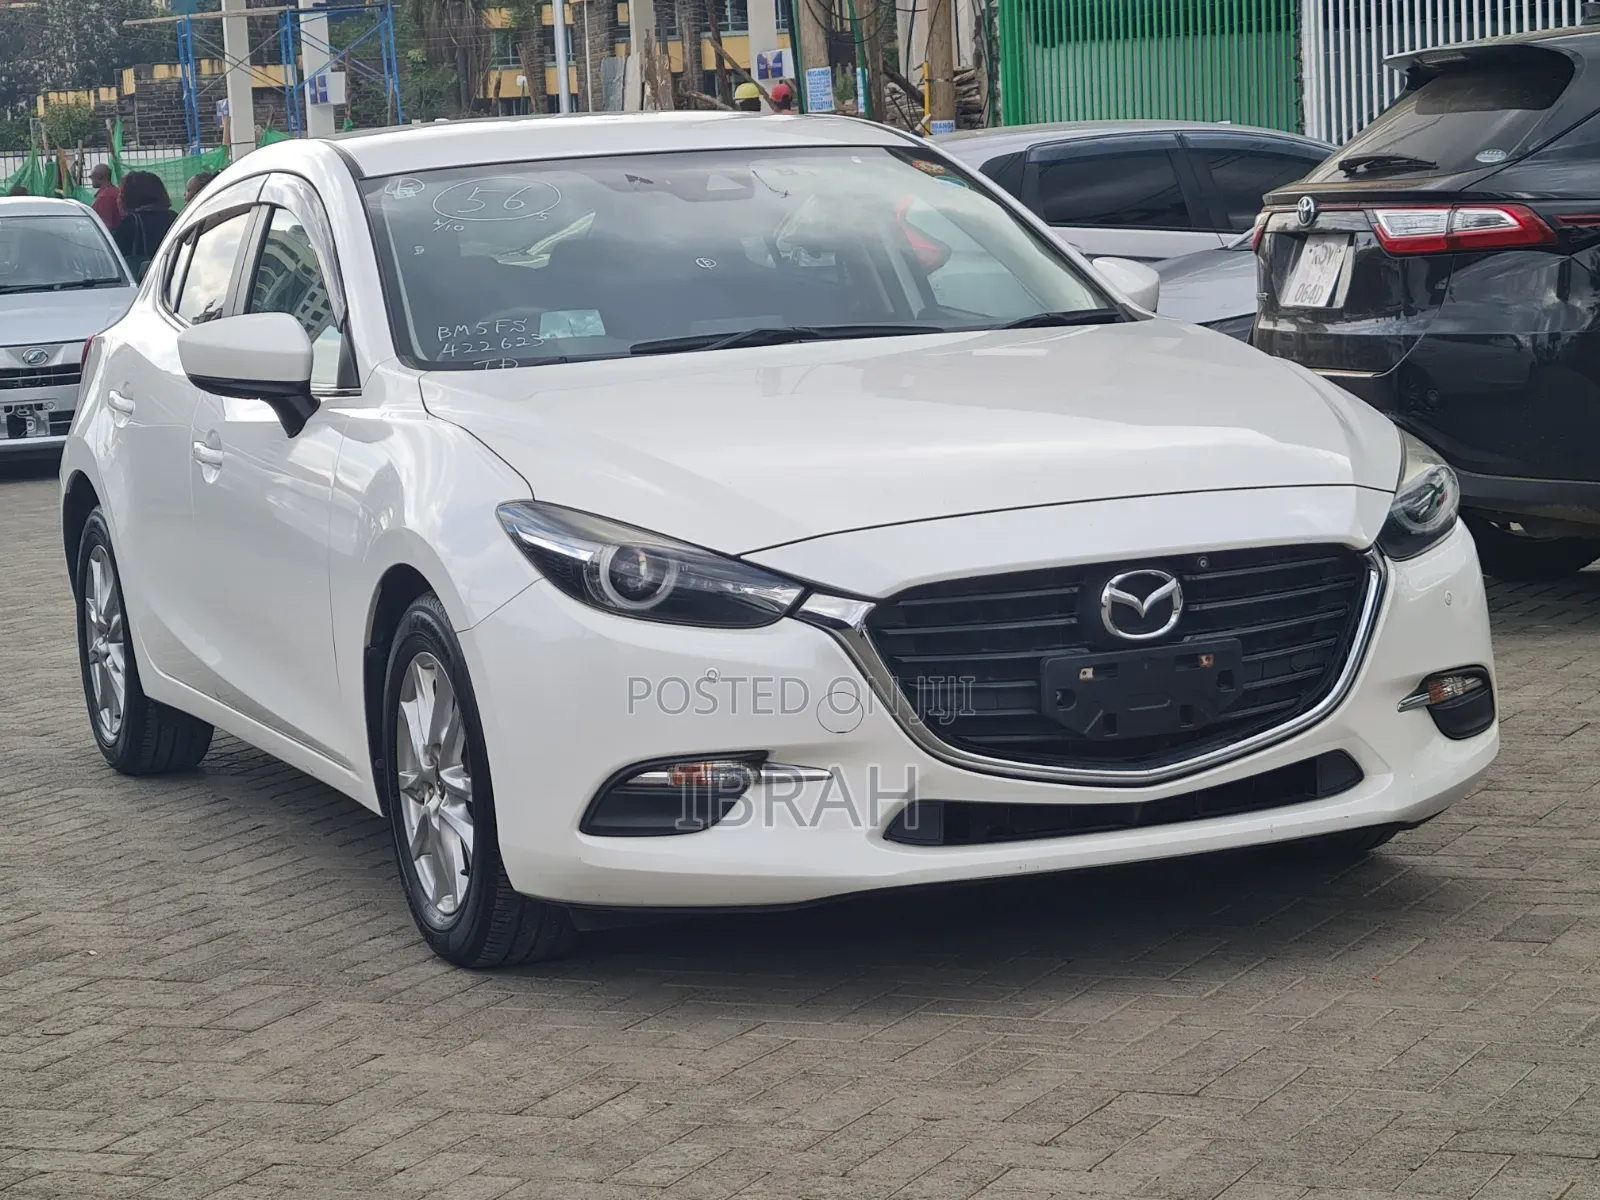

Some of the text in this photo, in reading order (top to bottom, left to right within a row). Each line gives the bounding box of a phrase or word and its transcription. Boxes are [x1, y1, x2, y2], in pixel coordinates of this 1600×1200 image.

[457, 185, 533, 214] 56
[437, 318, 528, 342] BM5FS
[442, 334, 545, 357] 422623
